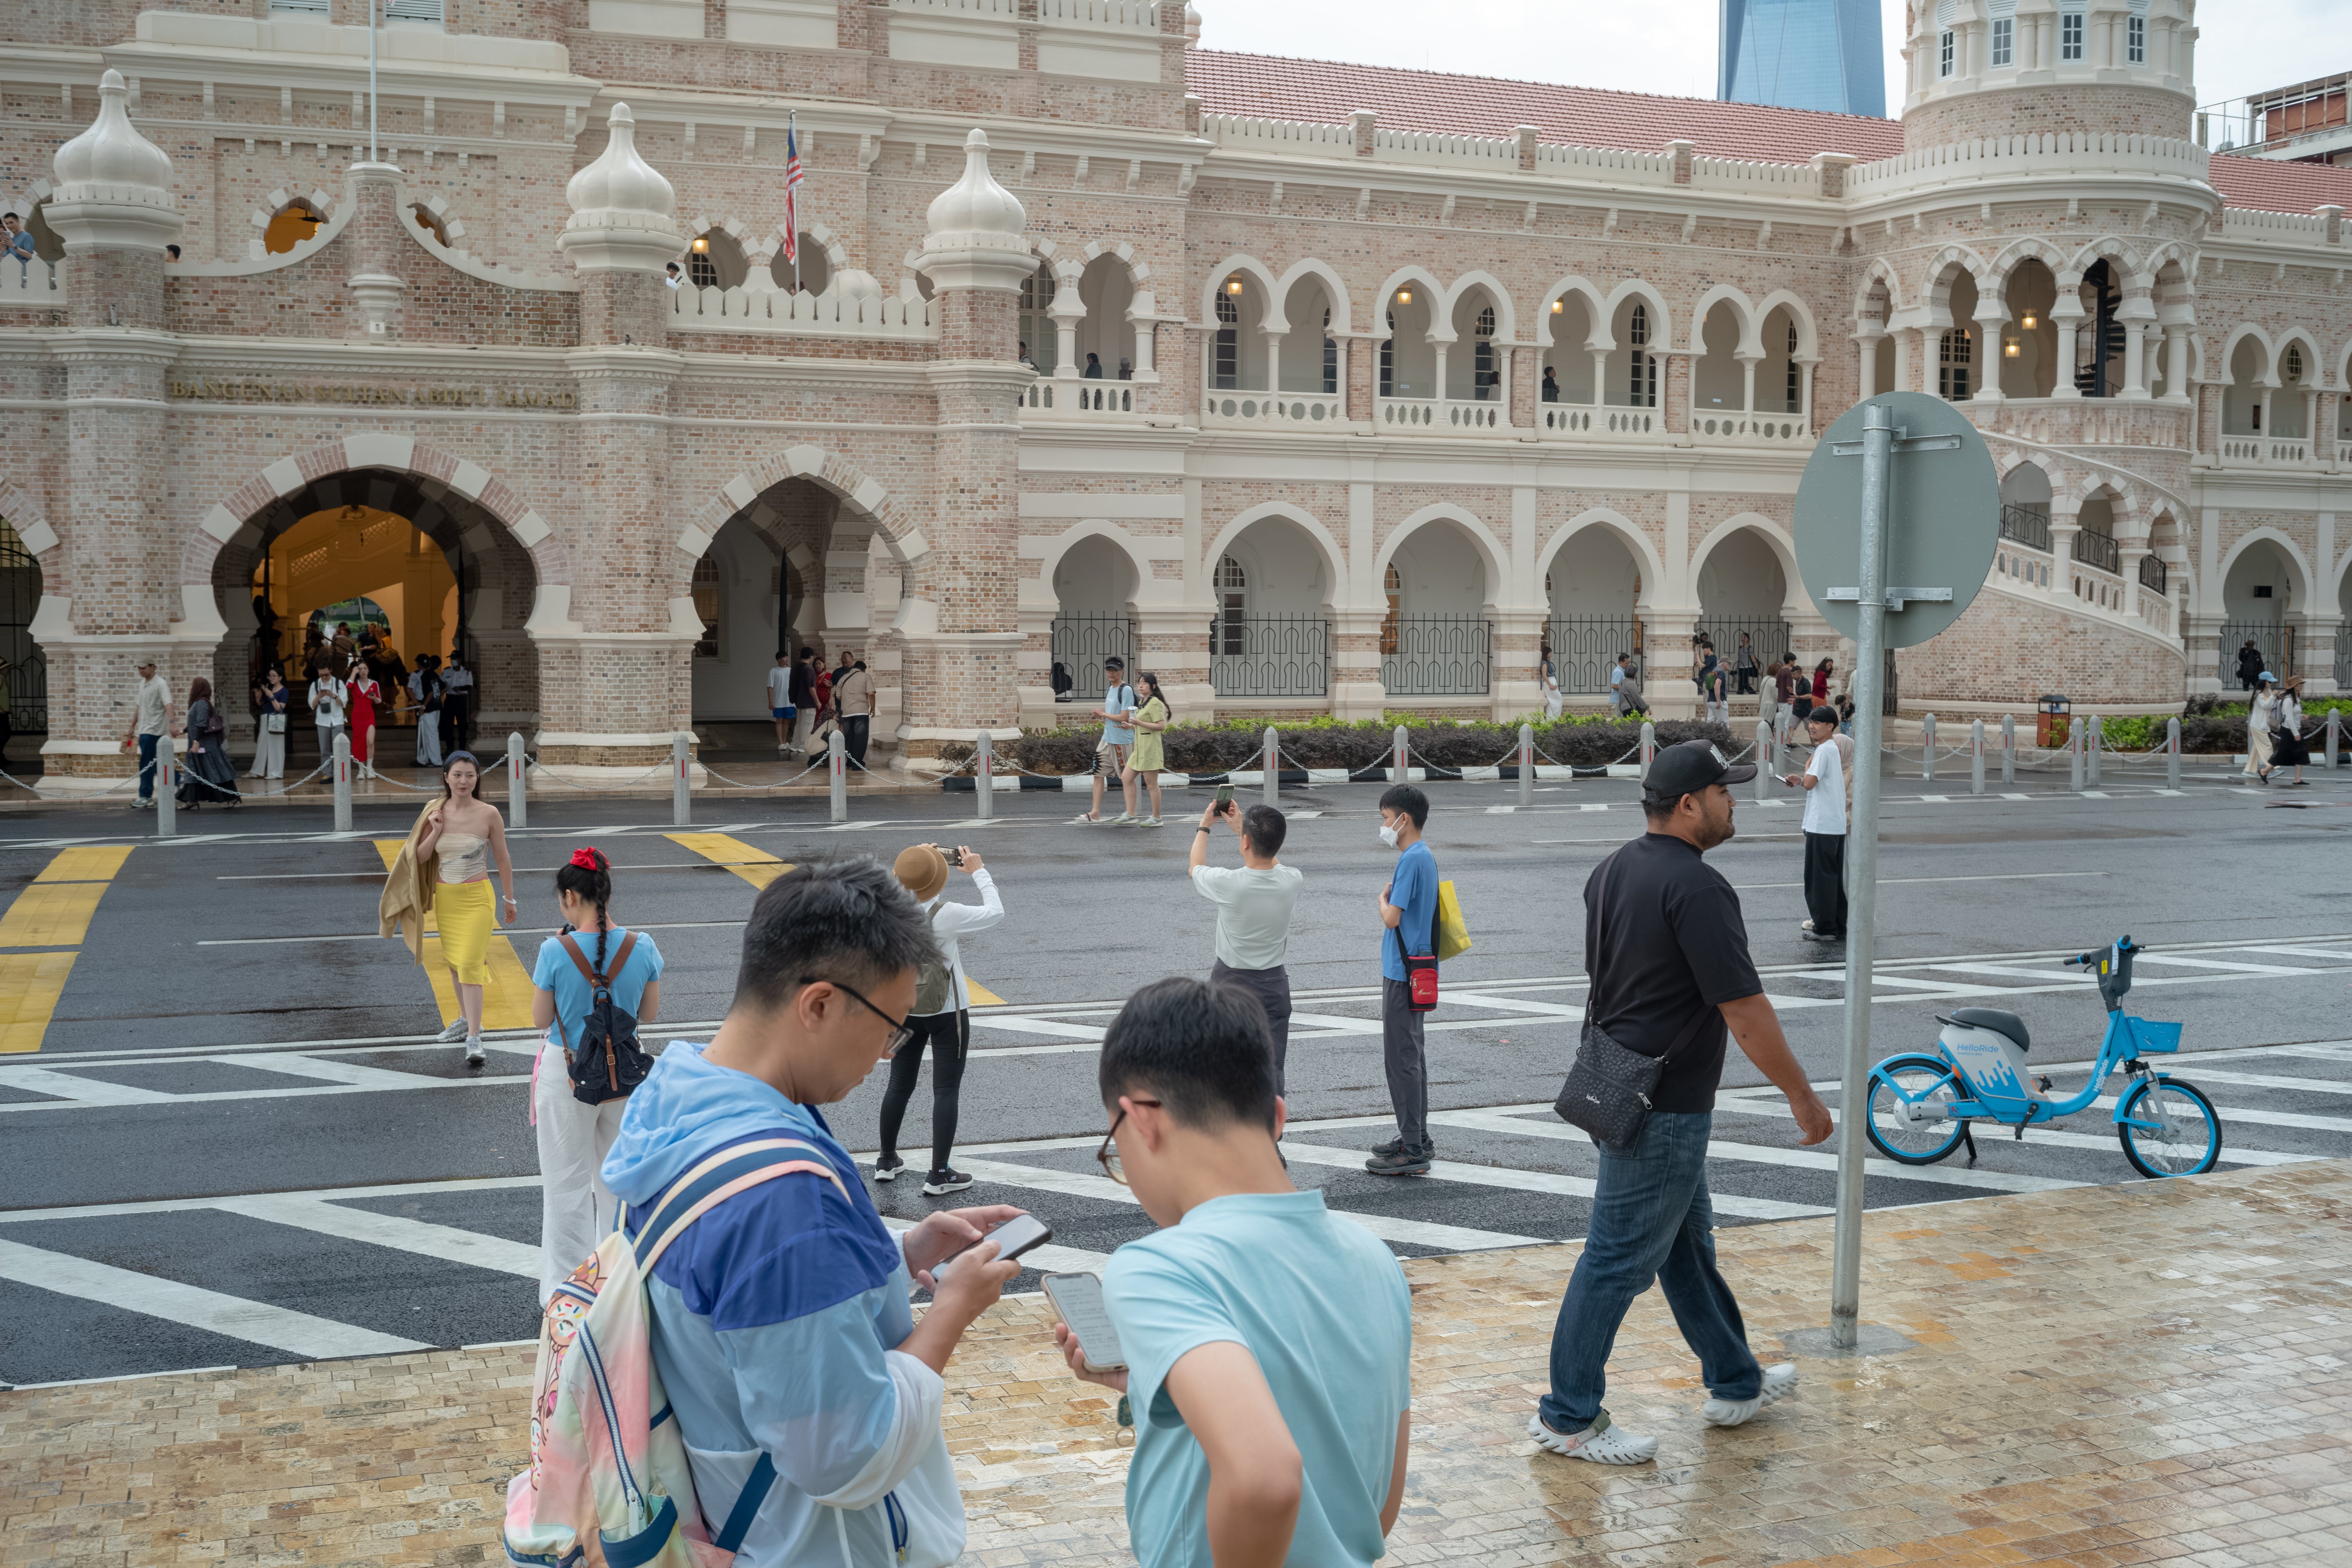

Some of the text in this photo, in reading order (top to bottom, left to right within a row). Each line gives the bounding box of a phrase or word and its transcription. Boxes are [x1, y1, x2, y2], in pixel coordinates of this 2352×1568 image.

[173, 379, 576, 407] BANGUNAN SULTAN ABDUL SAMAD
[1957, 1043, 1999, 1052] HelloRide
[2092, 1059, 2109, 1092] HelloRide
